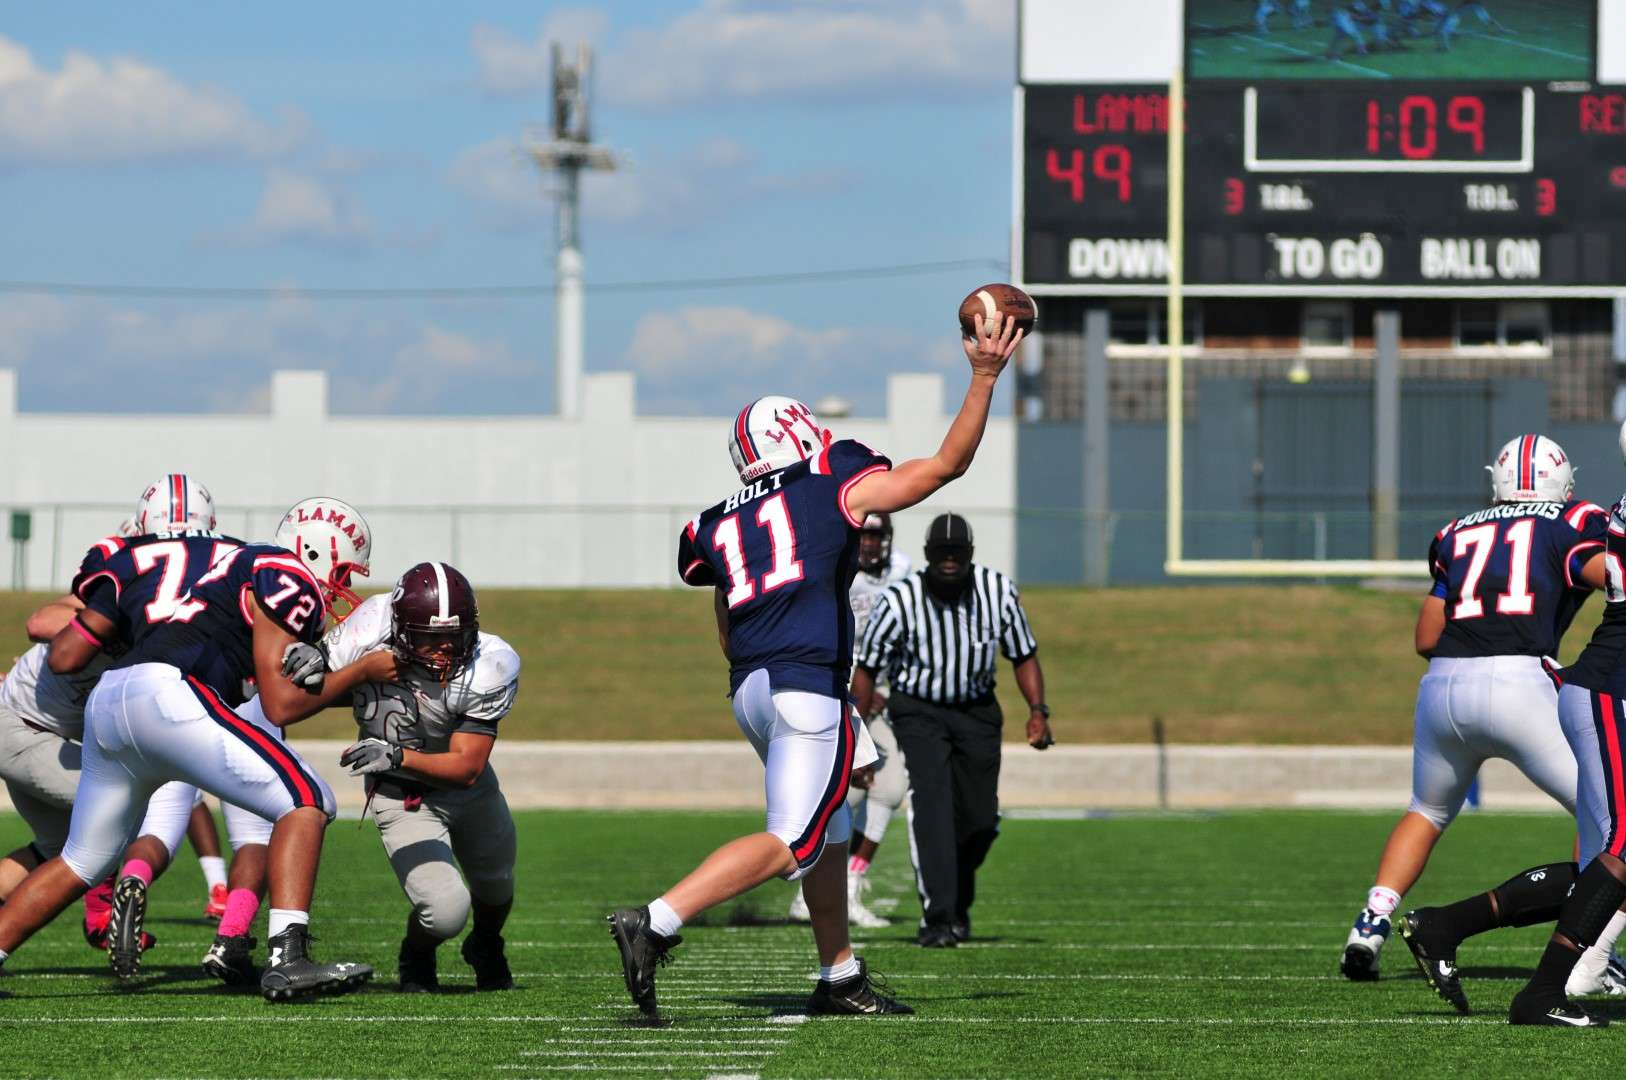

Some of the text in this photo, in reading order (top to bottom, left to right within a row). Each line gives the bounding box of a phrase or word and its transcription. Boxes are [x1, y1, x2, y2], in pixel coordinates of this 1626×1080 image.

[1073, 93, 1187, 135] LAMA
[1365, 95, 1485, 159] 1:09
[1579, 94, 1626, 134] RE
[1046, 145, 1132, 203] 49
[1225, 178, 1244, 215] 3
[1536, 178, 1556, 215] 3
[1274, 238, 1383, 278] TO GO
[1420, 238, 1540, 279] BALL ON
[724, 472, 784, 513] HOLT
[741, 462, 772, 482] Riddell
[298, 507, 366, 551] LAMAR
[1454, 502, 1564, 530] BOURGEOIS
[712, 492, 804, 609] 11
[1451, 518, 1536, 620] 71
[264, 574, 316, 632] 72
